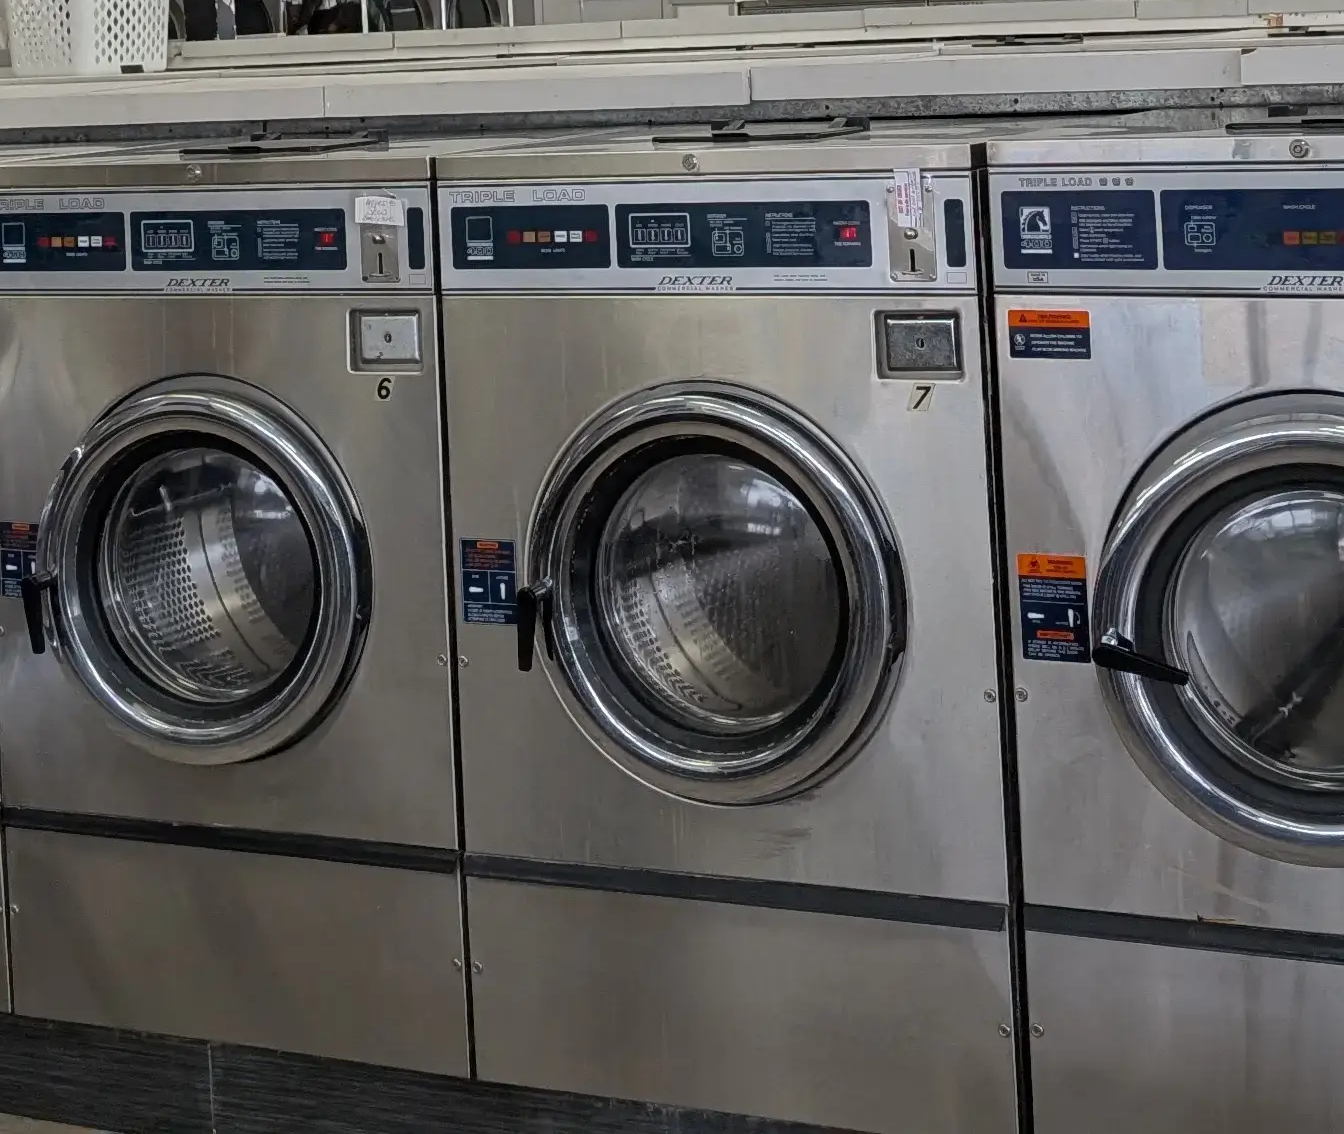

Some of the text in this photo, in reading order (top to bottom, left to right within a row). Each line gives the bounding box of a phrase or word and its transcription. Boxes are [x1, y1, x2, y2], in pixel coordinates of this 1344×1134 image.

[1019, 177, 1092, 187] TRIPLE LOAD
[449, 189, 586, 203] TRIPLE LOAD
[59, 198, 105, 209] LOAD
[167, 278, 230, 287] DEXTER
[658, 276, 733, 286] DEXTER
[1267, 275, 1344, 286] DEXTER
[377, 377, 392, 400] 6
[912, 385, 932, 410] 7
